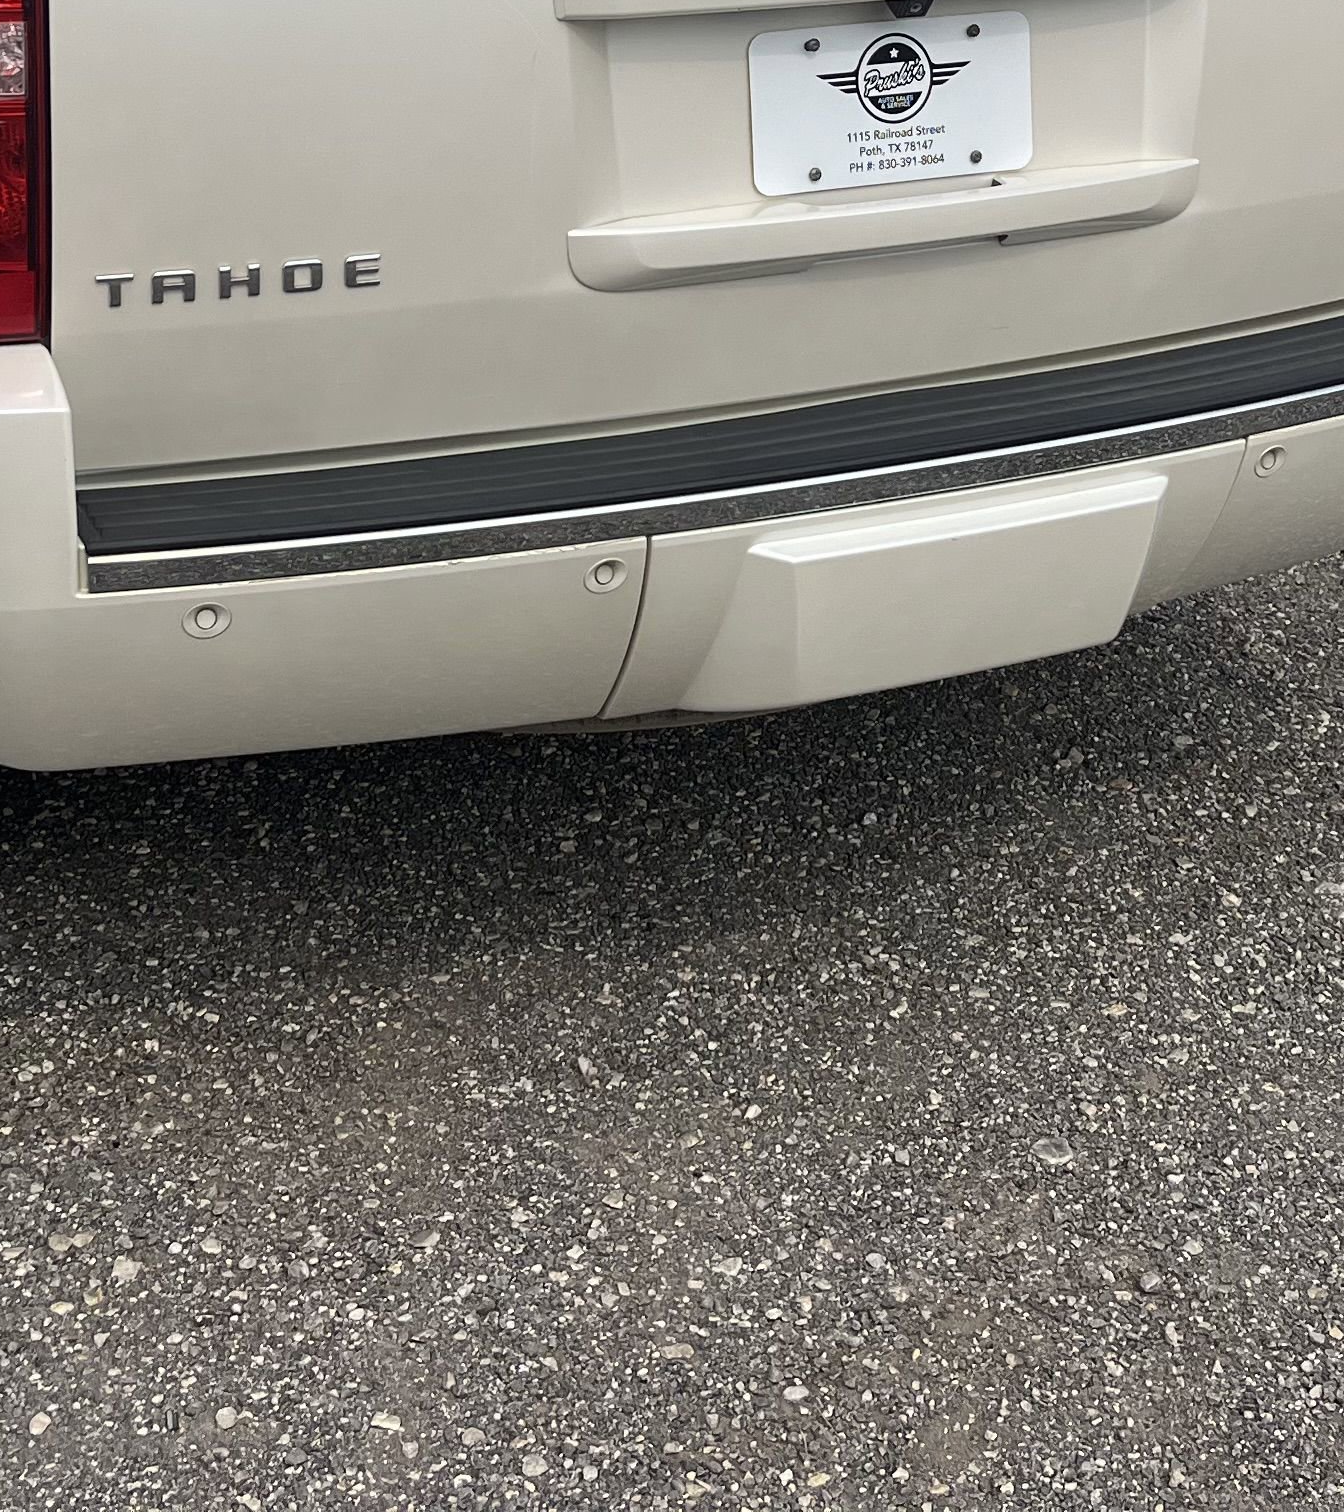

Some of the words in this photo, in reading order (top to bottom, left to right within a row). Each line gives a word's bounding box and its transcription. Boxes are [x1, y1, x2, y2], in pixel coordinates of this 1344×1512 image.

[863, 57, 926, 99] Pruski's
[847, 131, 871, 143] 1115
[873, 126, 913, 140] Railroad
[916, 125, 946, 137] Street
[859, 144, 886, 157] Poth,
[888, 142, 902, 154] TX
[903, 139, 934, 153] 78147
[849, 162, 864, 174] PH
[866, 160, 875, 171] #:
[878, 153, 945, 171] 830-391-8064
[94, 253, 382, 308] TAHOE
